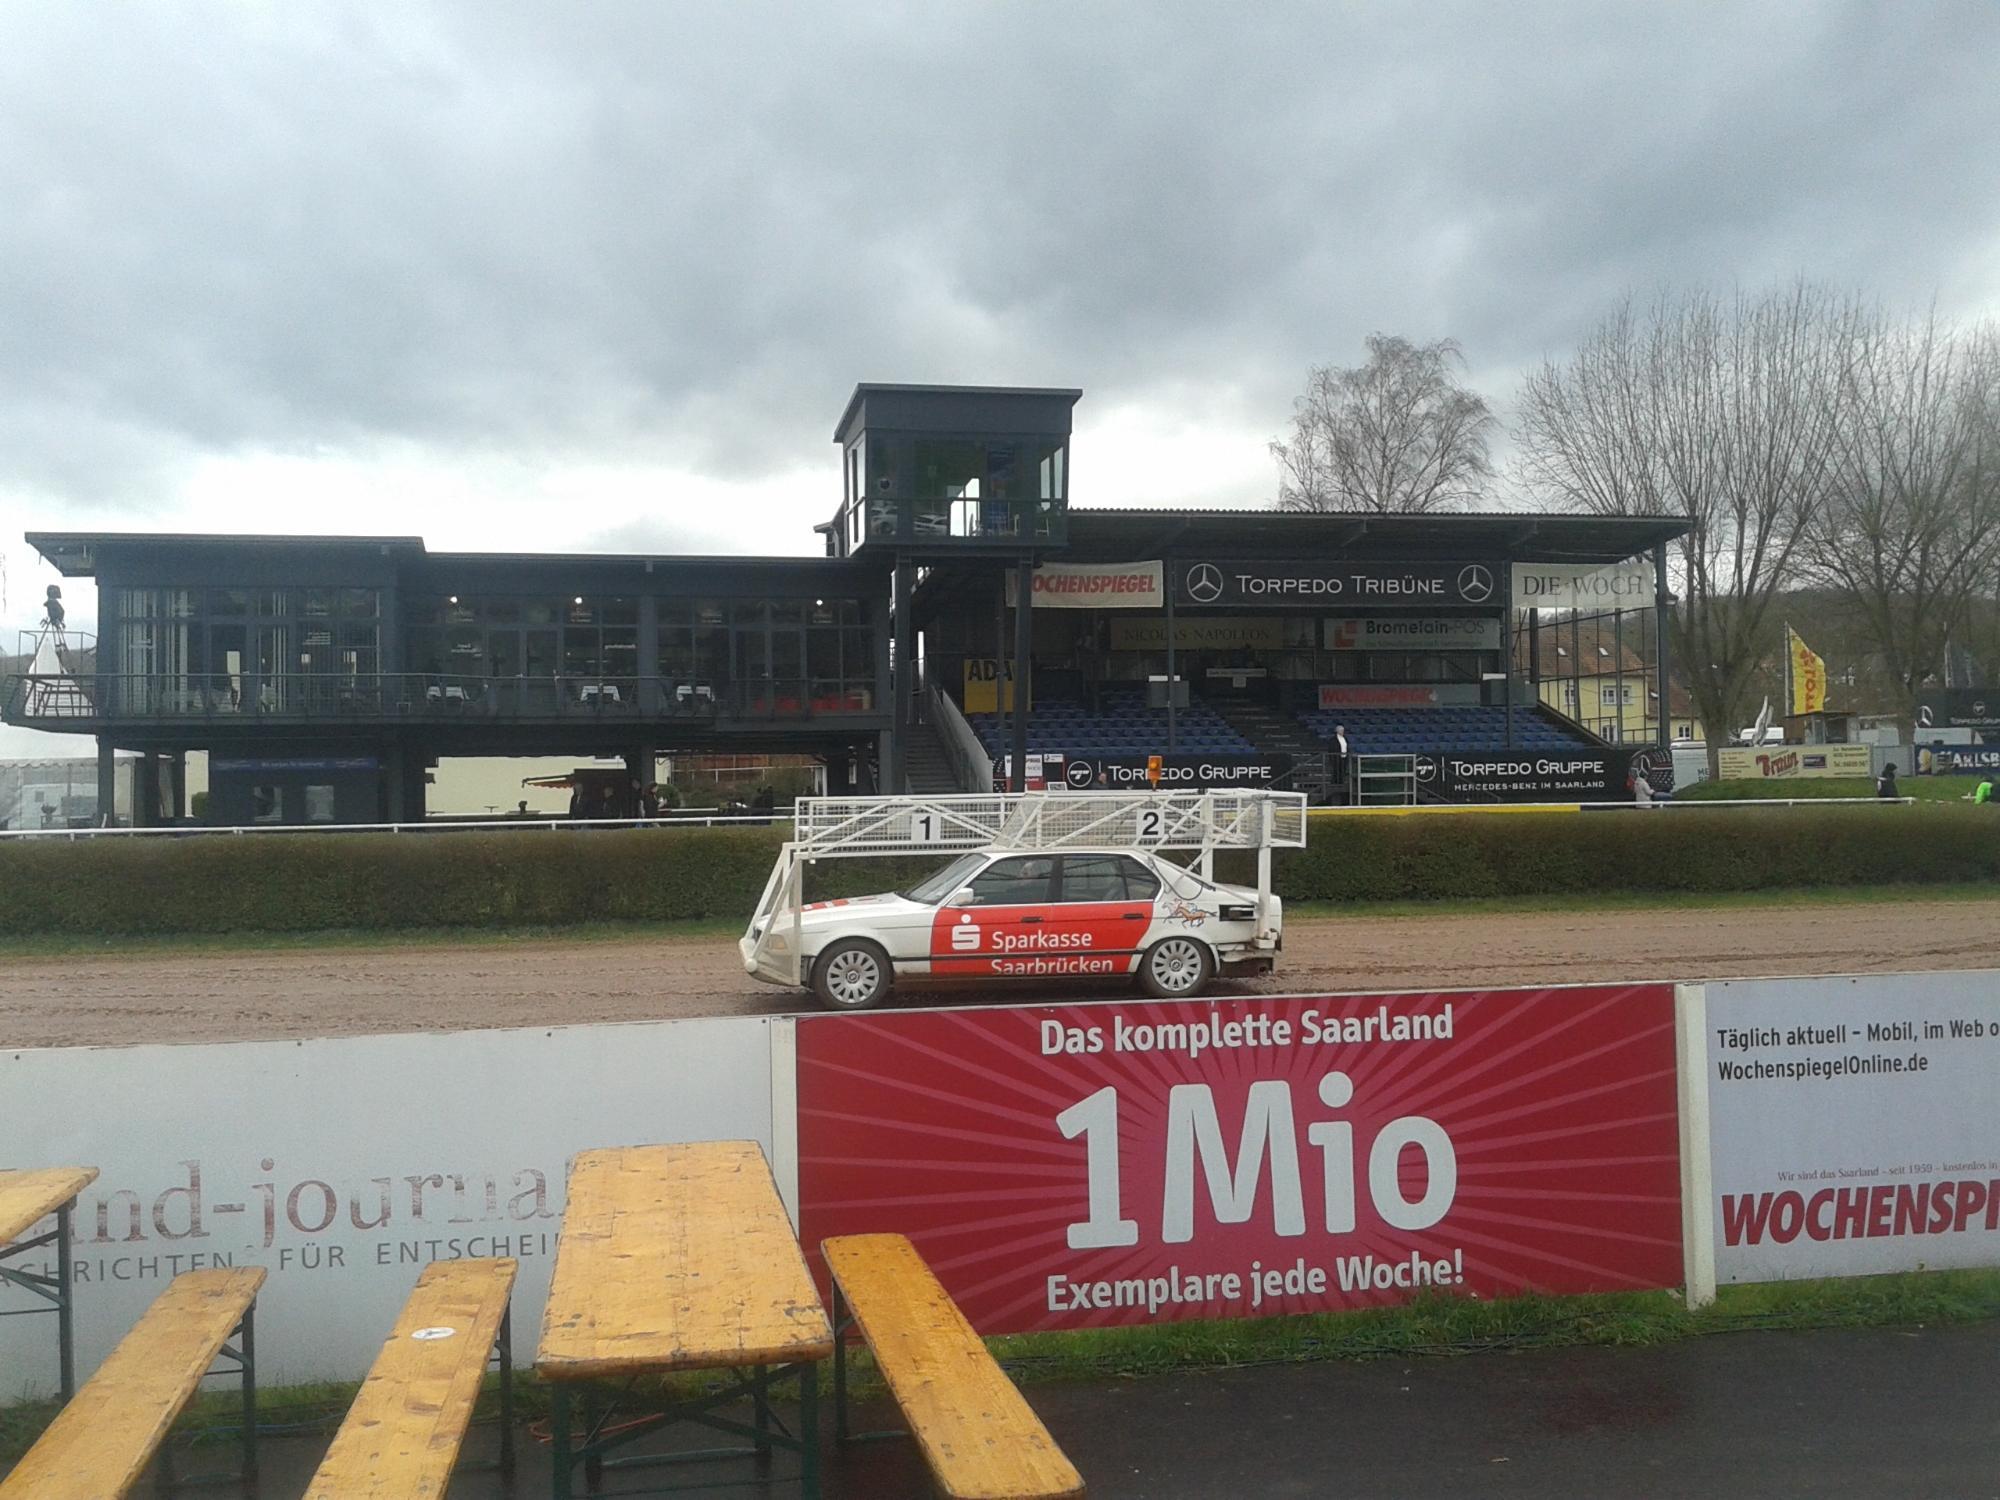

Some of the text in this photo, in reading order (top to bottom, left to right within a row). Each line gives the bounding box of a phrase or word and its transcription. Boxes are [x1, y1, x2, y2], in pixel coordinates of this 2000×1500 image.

[1235, 574, 1445, 594] TORPEDO TRIBÜNE
[1523, 575, 1562, 596] DIE
[1108, 763, 1271, 781] TOREDO GRUPPE
[1451, 759, 1604, 776] TORPEDO GRUPPE
[1541, 781, 1551, 790] IM
[1555, 780, 1605, 790] SAARLAND
[919, 815, 934, 841] 1
[1142, 812, 1160, 837] 2
[991, 930, 1093, 951] Sparkasse
[991, 956, 1114, 976] Saarbrücken
[1041, 1003, 1455, 1058] Das komplette Saarland
[1717, 1028, 1781, 1052] Täglich
[1786, 1025, 1847, 1047] aktuell
[1867, 1021, 1918, 1044] Mobil,
[1924, 1021, 1944, 1040] im
[1949, 1019, 1984, 1039] Web
[1718, 1053, 1929, 1081] WochenspiegelOnline.de
[1056, 1071, 1458, 1249] 1 Mio
[1839, 1165, 1880, 1179] Saarland
[1721, 1179, 2000, 1247] WOCHENSPI
[280, 1243, 346, 1271] FÜR
[378, 1233, 560, 1264] ENTSCHEI
[1046, 1248, 1465, 1315] Exemplare jede Woche!
